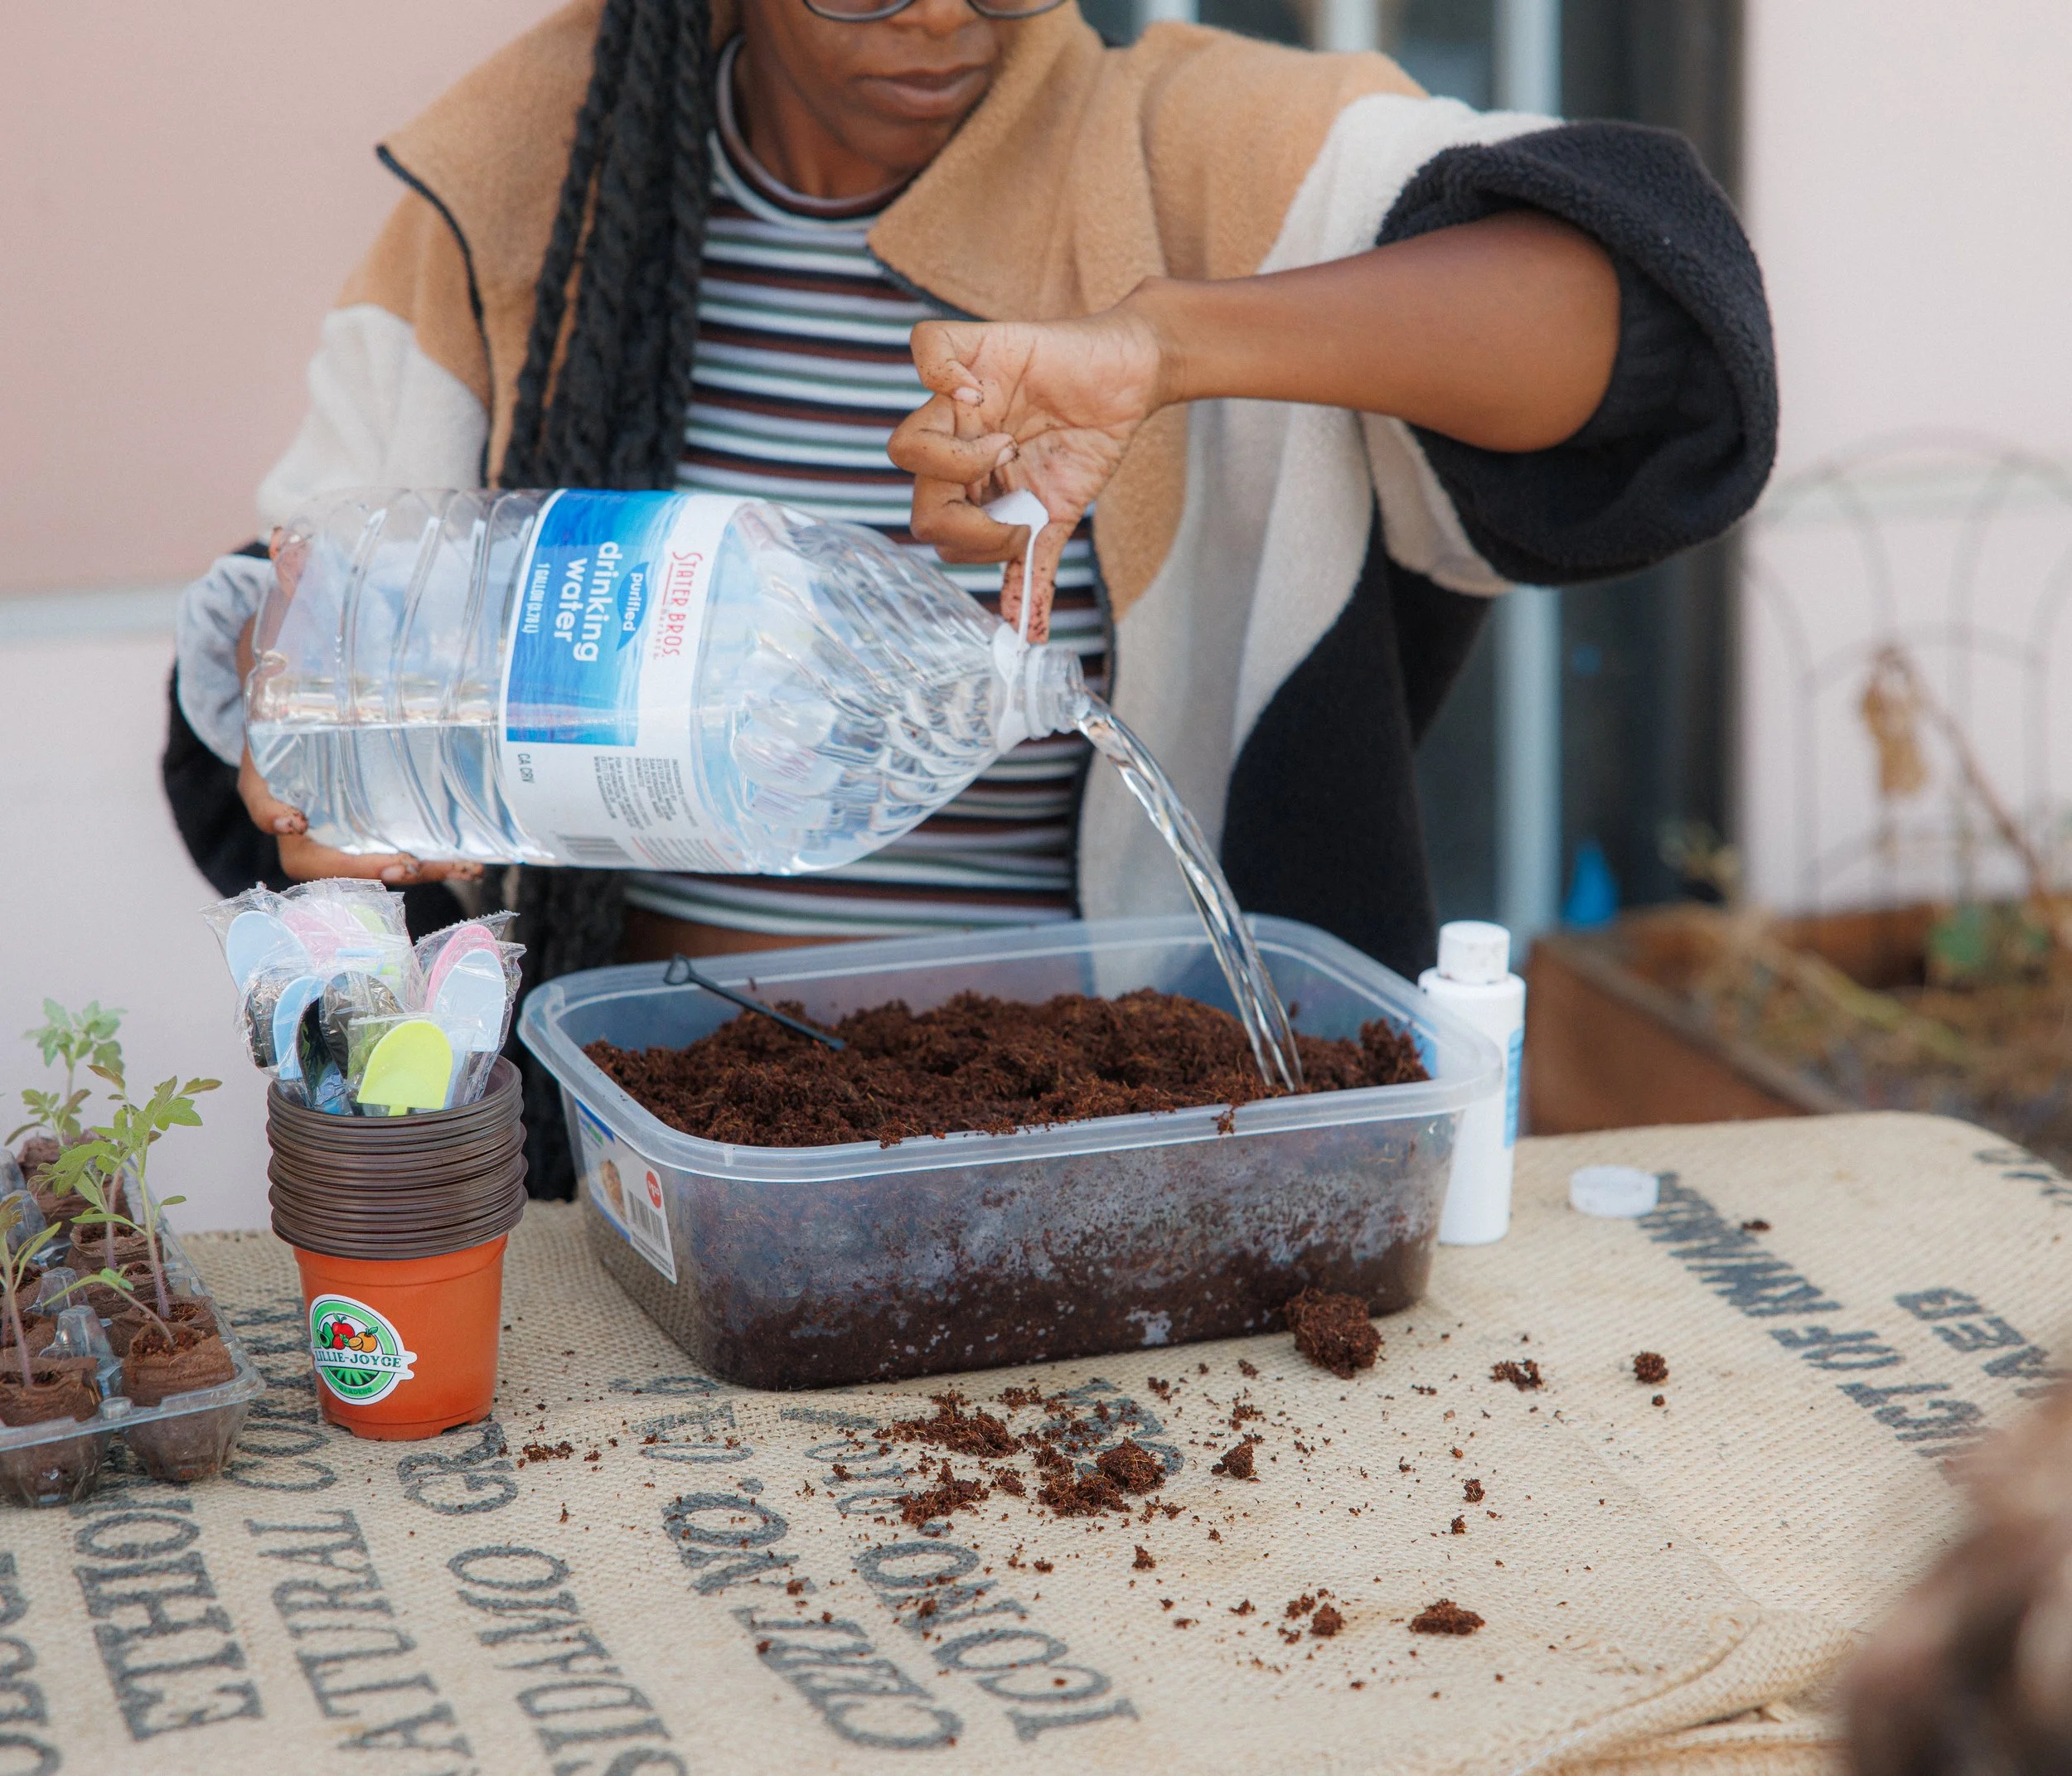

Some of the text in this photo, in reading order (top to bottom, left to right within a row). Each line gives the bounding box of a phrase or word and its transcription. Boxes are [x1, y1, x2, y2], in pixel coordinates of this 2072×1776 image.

[529, 569, 549, 602] GALLON
[554, 557, 588, 642] water
[573, 541, 623, 661] drinking
[622, 573, 644, 631] purified
[670, 551, 704, 607] STATER
[518, 753, 536, 783] CA CRV
[1635, 1170, 1843, 1317] RWAND
[316, 1351, 401, 1368] LILLIE-JOYCE
[1767, 1326, 1905, 1370] OF
[339, 1385, 373, 1396] GARDENS
[244, 1508, 481, 1776] ATURAL
